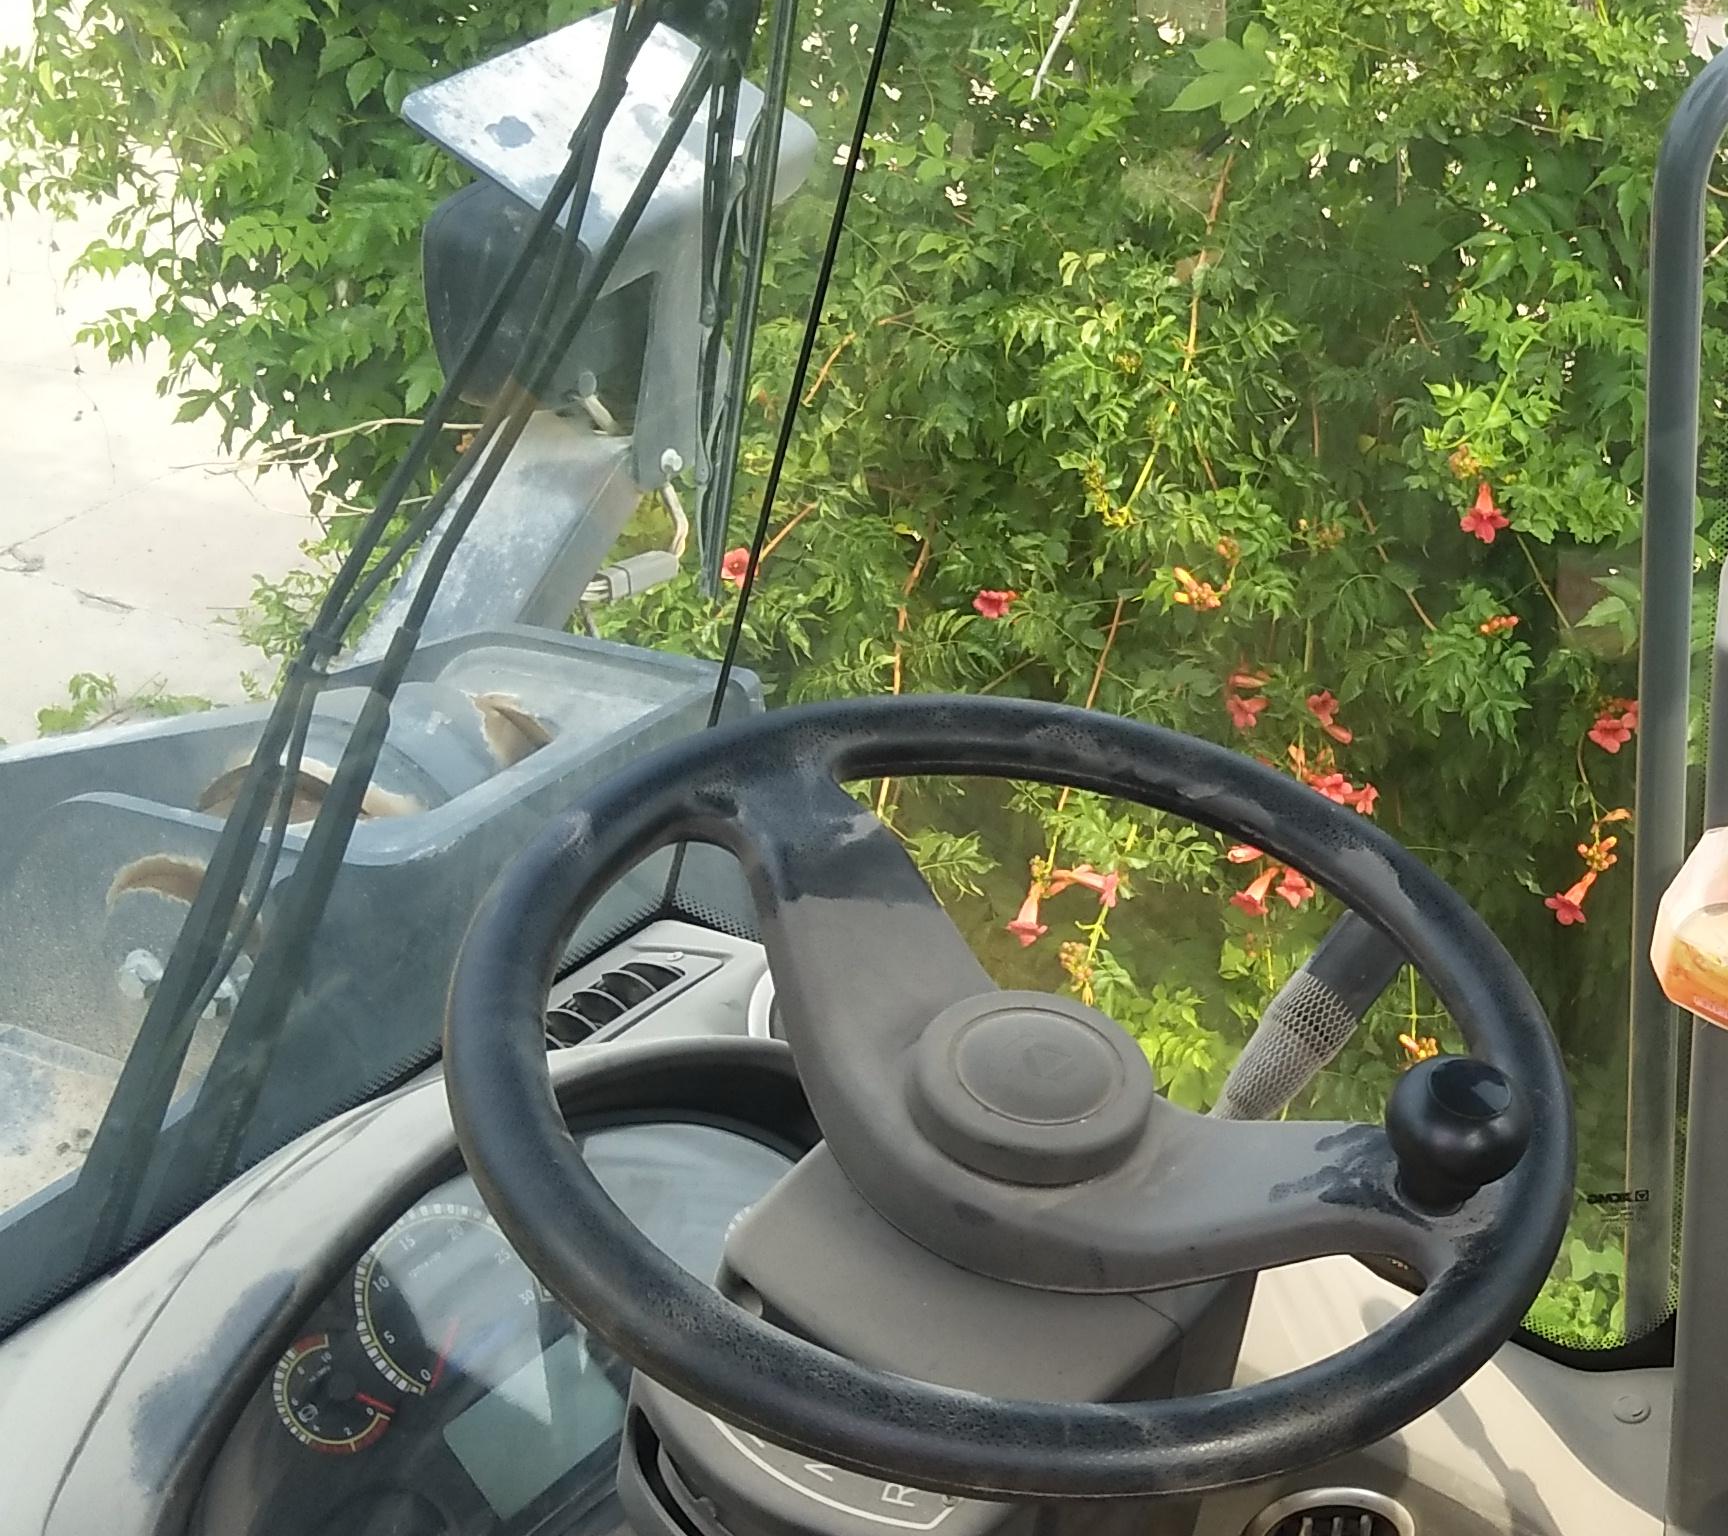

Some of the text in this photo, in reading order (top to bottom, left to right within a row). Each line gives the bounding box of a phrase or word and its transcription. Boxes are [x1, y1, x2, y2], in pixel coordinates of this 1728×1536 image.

[399, 1235, 416, 1251] 15
[371, 1276, 390, 1293] 10
[518, 1289, 535, 1306] 30
[384, 1330, 396, 1345] 5
[420, 1368, 432, 1382] 0
